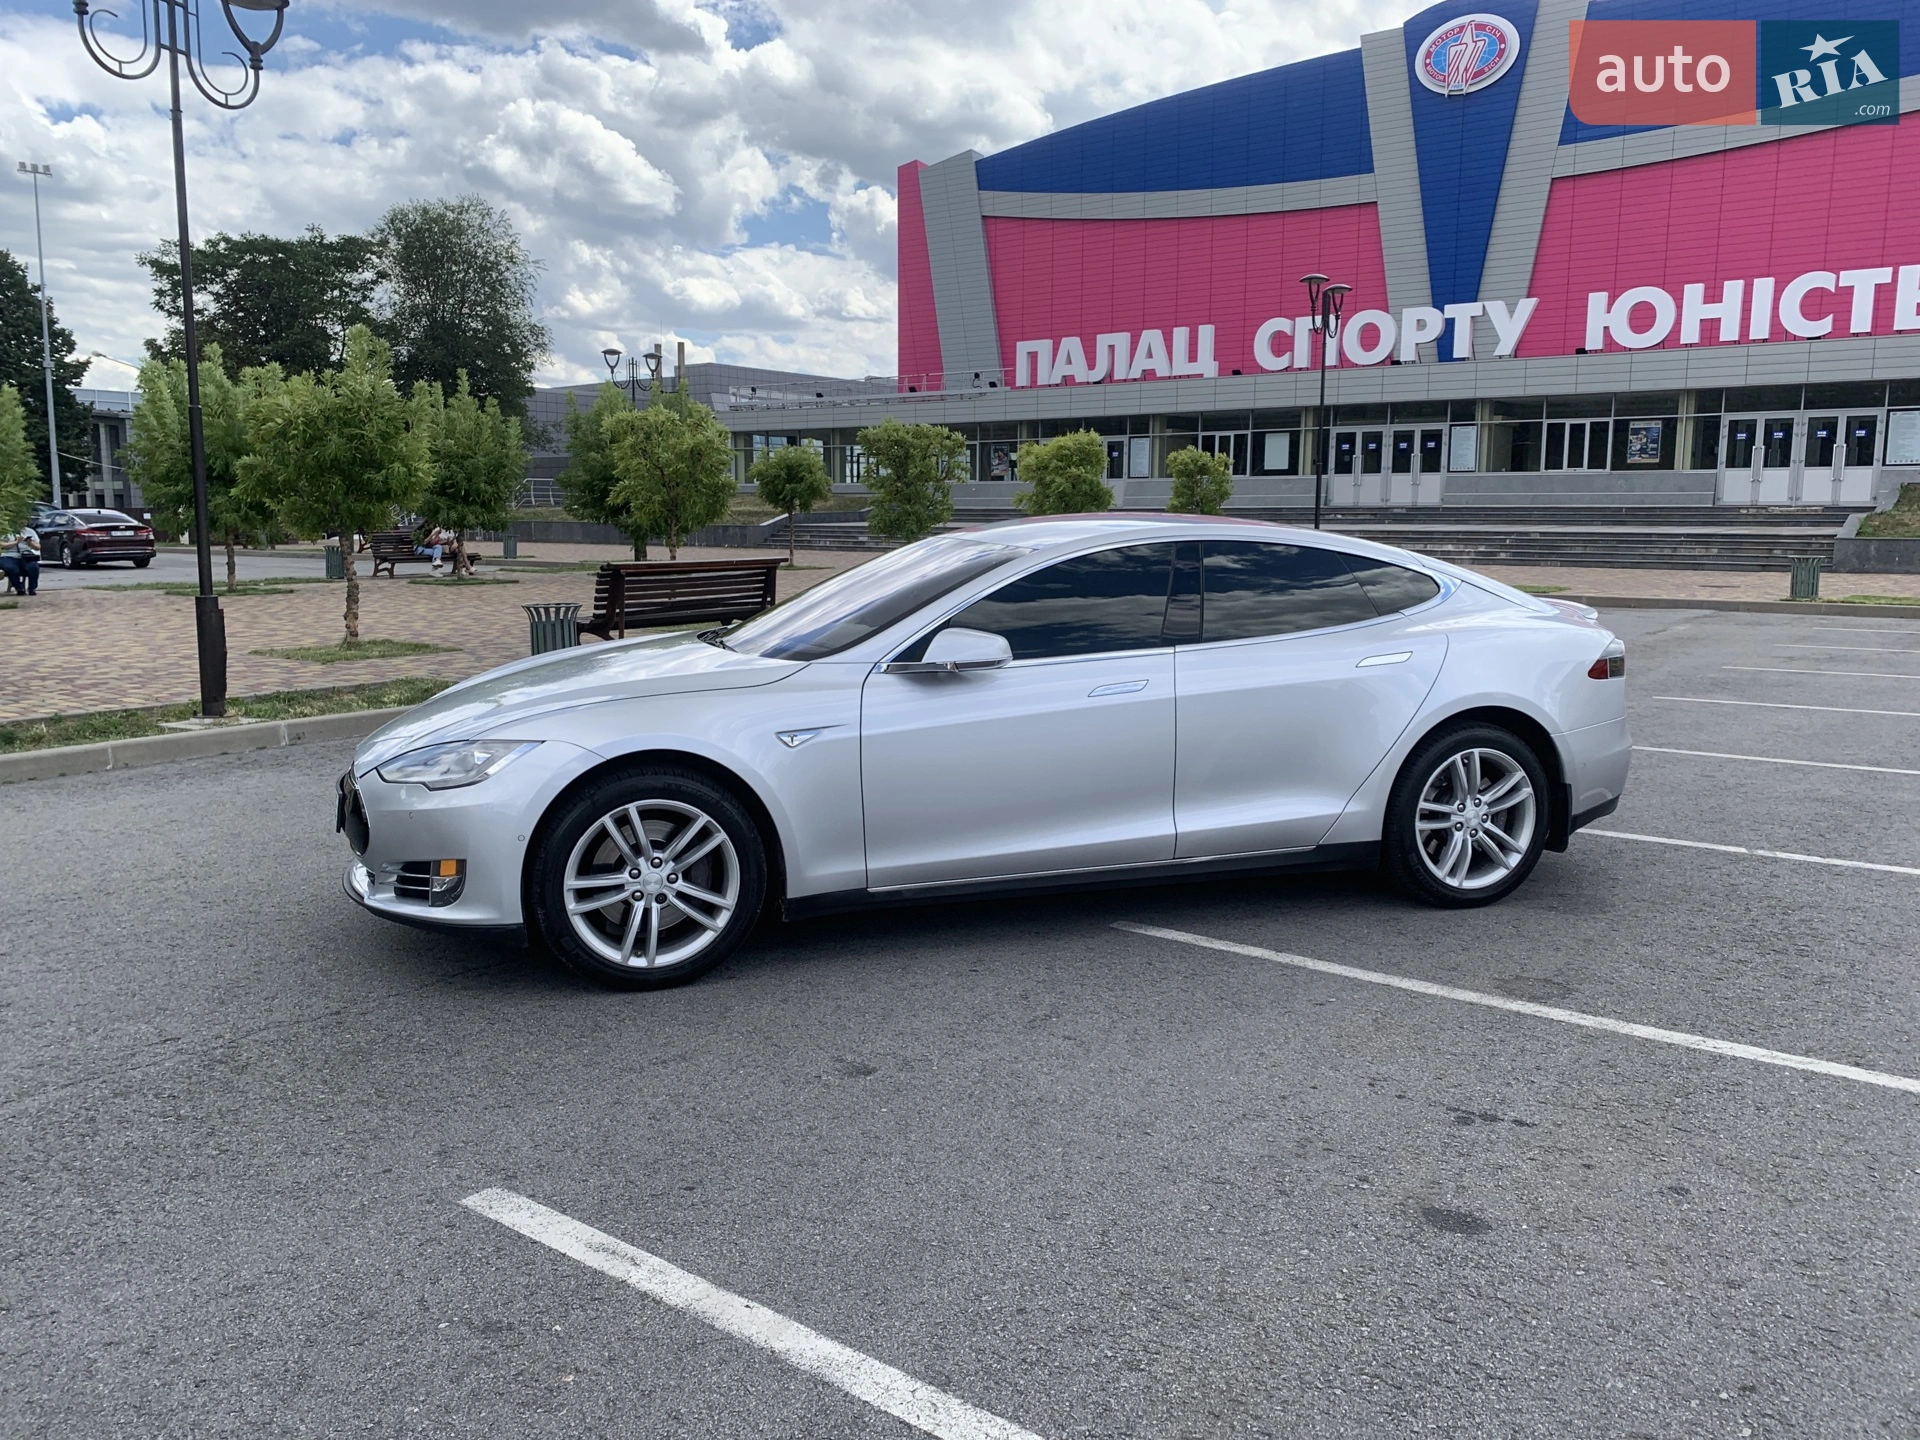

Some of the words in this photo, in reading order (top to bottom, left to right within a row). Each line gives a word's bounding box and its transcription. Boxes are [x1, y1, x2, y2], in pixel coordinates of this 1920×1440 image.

[1429, 27, 1460, 53] МОТОР
[1485, 25, 1501, 38] СІЧ
[1425, 65, 1444, 81] MOTOR
[1484, 57, 1500, 73] SICH
[1015, 324, 1219, 387] ПАЛАЦ
[1253, 297, 1540, 371] СПОРТУ
